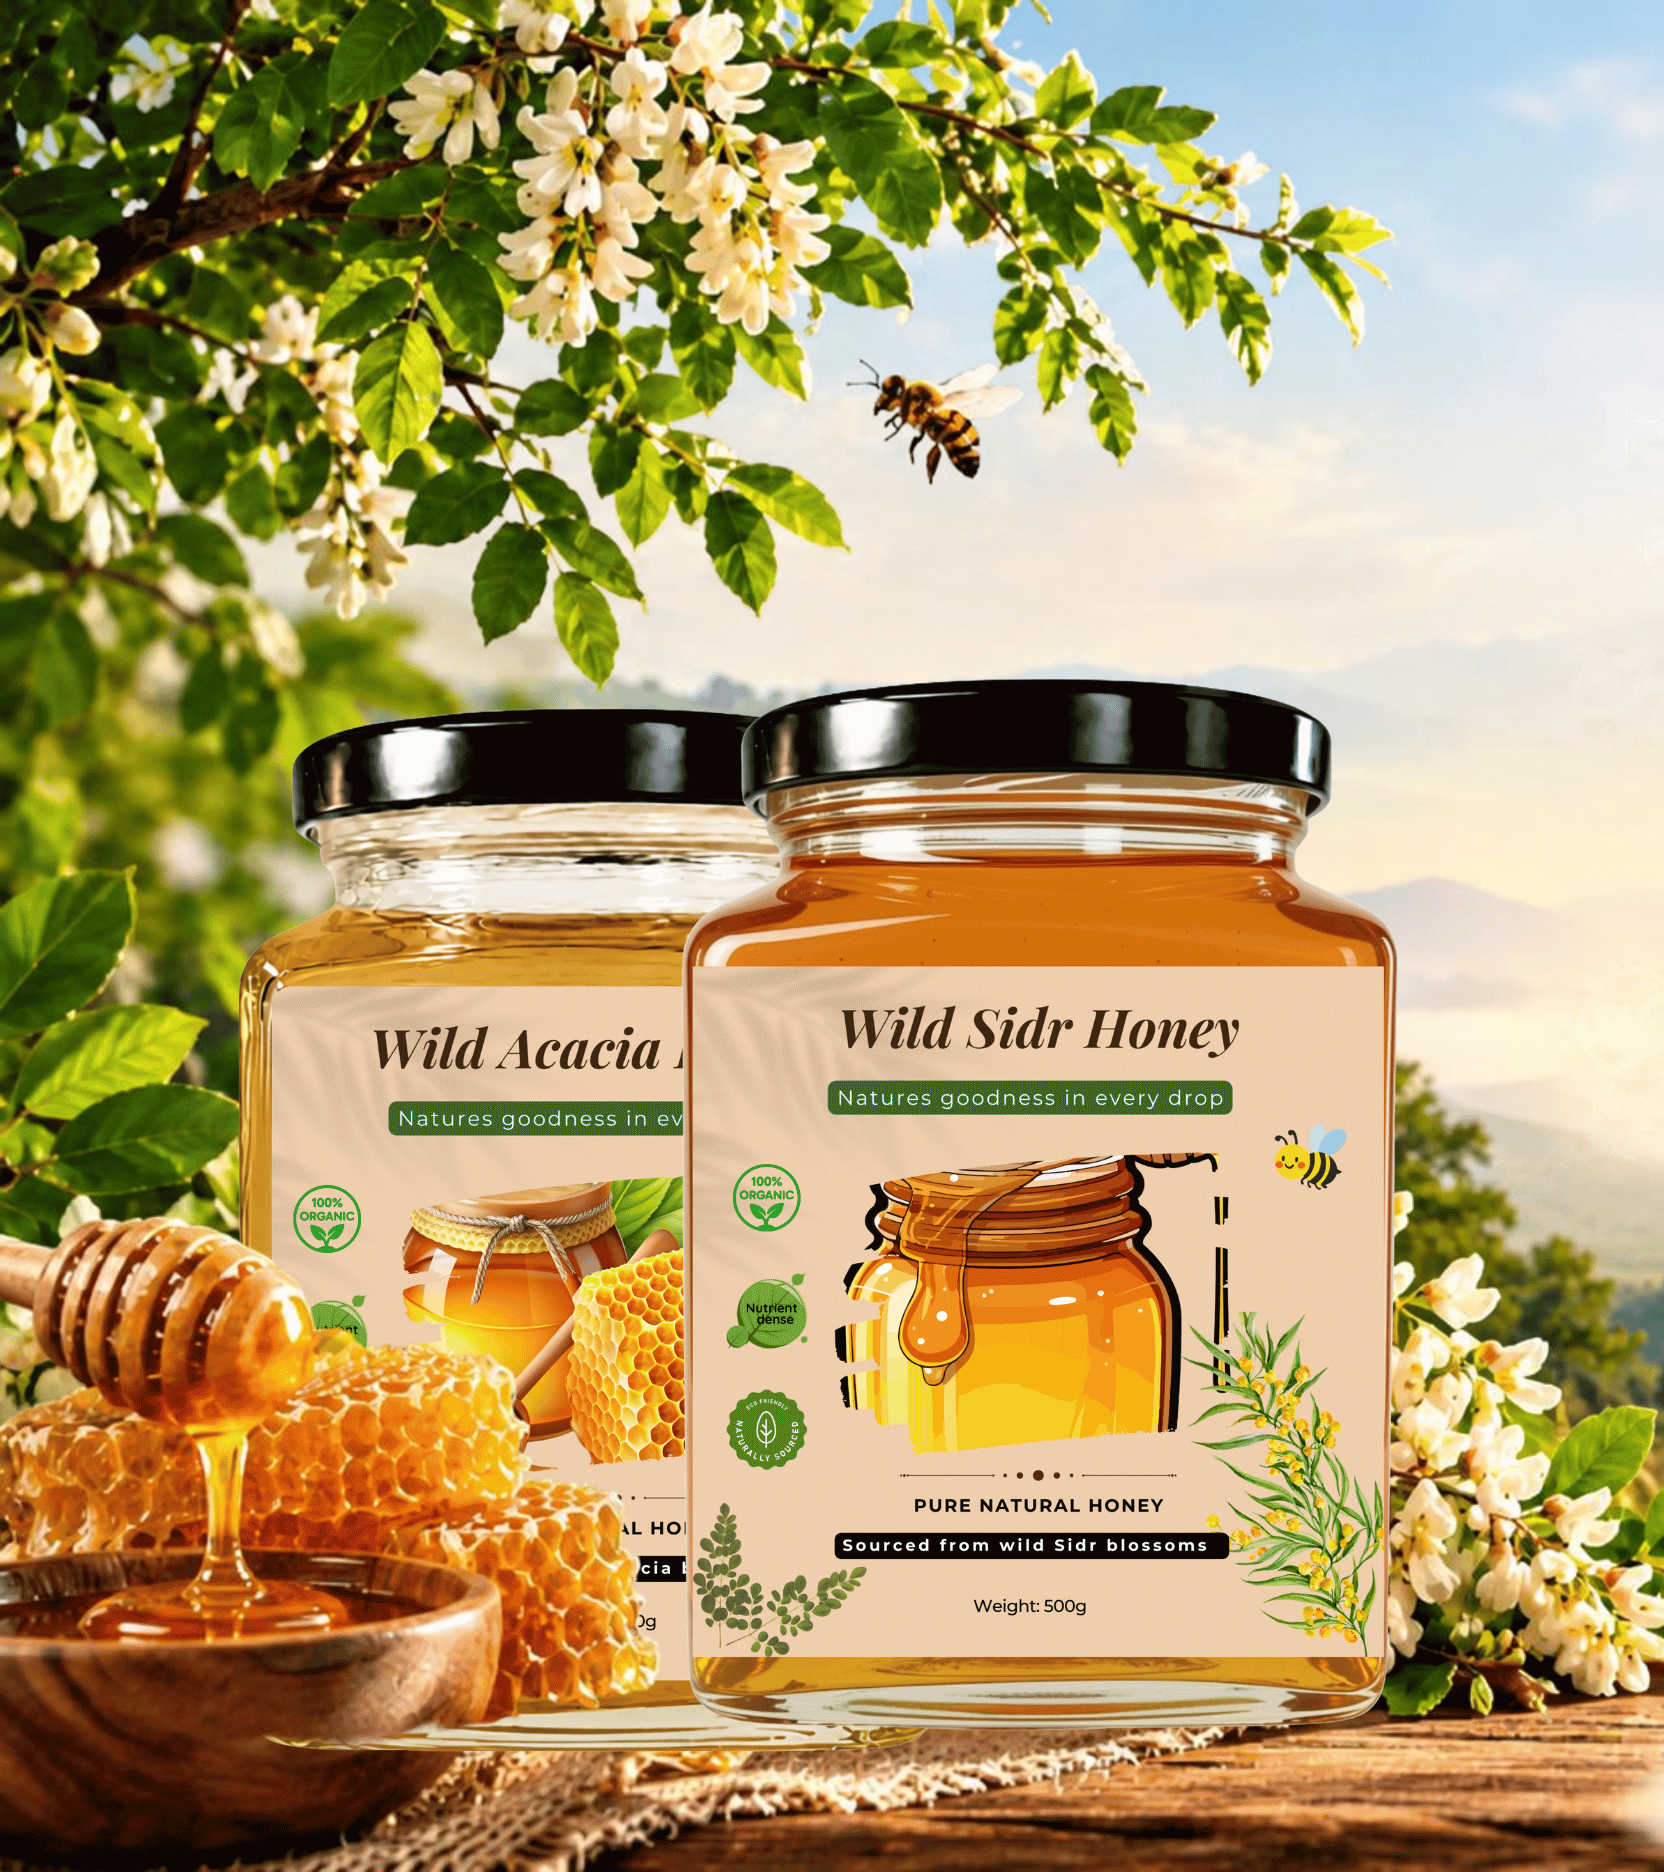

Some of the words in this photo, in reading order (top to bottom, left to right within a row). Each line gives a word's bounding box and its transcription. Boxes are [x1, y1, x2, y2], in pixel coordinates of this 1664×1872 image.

[842, 1005, 956, 1050] Wild
[965, 1005, 1074, 1050] Sidr
[1082, 1009, 1240, 1059] Honey
[373, 1025, 489, 1070] Wild
[494, 1026, 661, 1070] Acacia
[838, 1089, 931, 1106] Natures
[940, 1089, 1055, 1110] goodness
[1065, 1089, 1085, 1106] in
[1095, 1093, 1160, 1110] every
[1168, 1089, 1223, 1110] drop
[399, 1110, 493, 1127] Natures
[502, 1110, 617, 1131] goodness
[627, 1109, 647, 1127] in
[751, 1176, 783, 1187] 100%
[311, 1197, 343, 1208] 100%
[739, 1190, 795, 1200] ORGANIC
[299, 1211, 355, 1221] ORGANIC
[746, 1303, 797, 1314] Nutrient
[757, 1315, 794, 1325] dense
[745, 1400, 758, 1410] ECO
[759, 1398, 789, 1411] FRIENDLY
[735, 1420, 770, 1462] NATURALLY
[773, 1421, 799, 1460] SOURCED
[914, 1498, 971, 1513] PURE
[980, 1498, 1081, 1513] NATURAL
[1089, 1498, 1164, 1513] HONEY
[842, 1537, 929, 1552] Sourced
[939, 1537, 989, 1552] from
[999, 1537, 1044, 1552] wild
[1054, 1537, 1097, 1552] Sidr
[1107, 1537, 1207, 1552] blossoms
[973, 1598, 1040, 1617] Weight:
[1043, 1599, 1087, 1617] 500g
